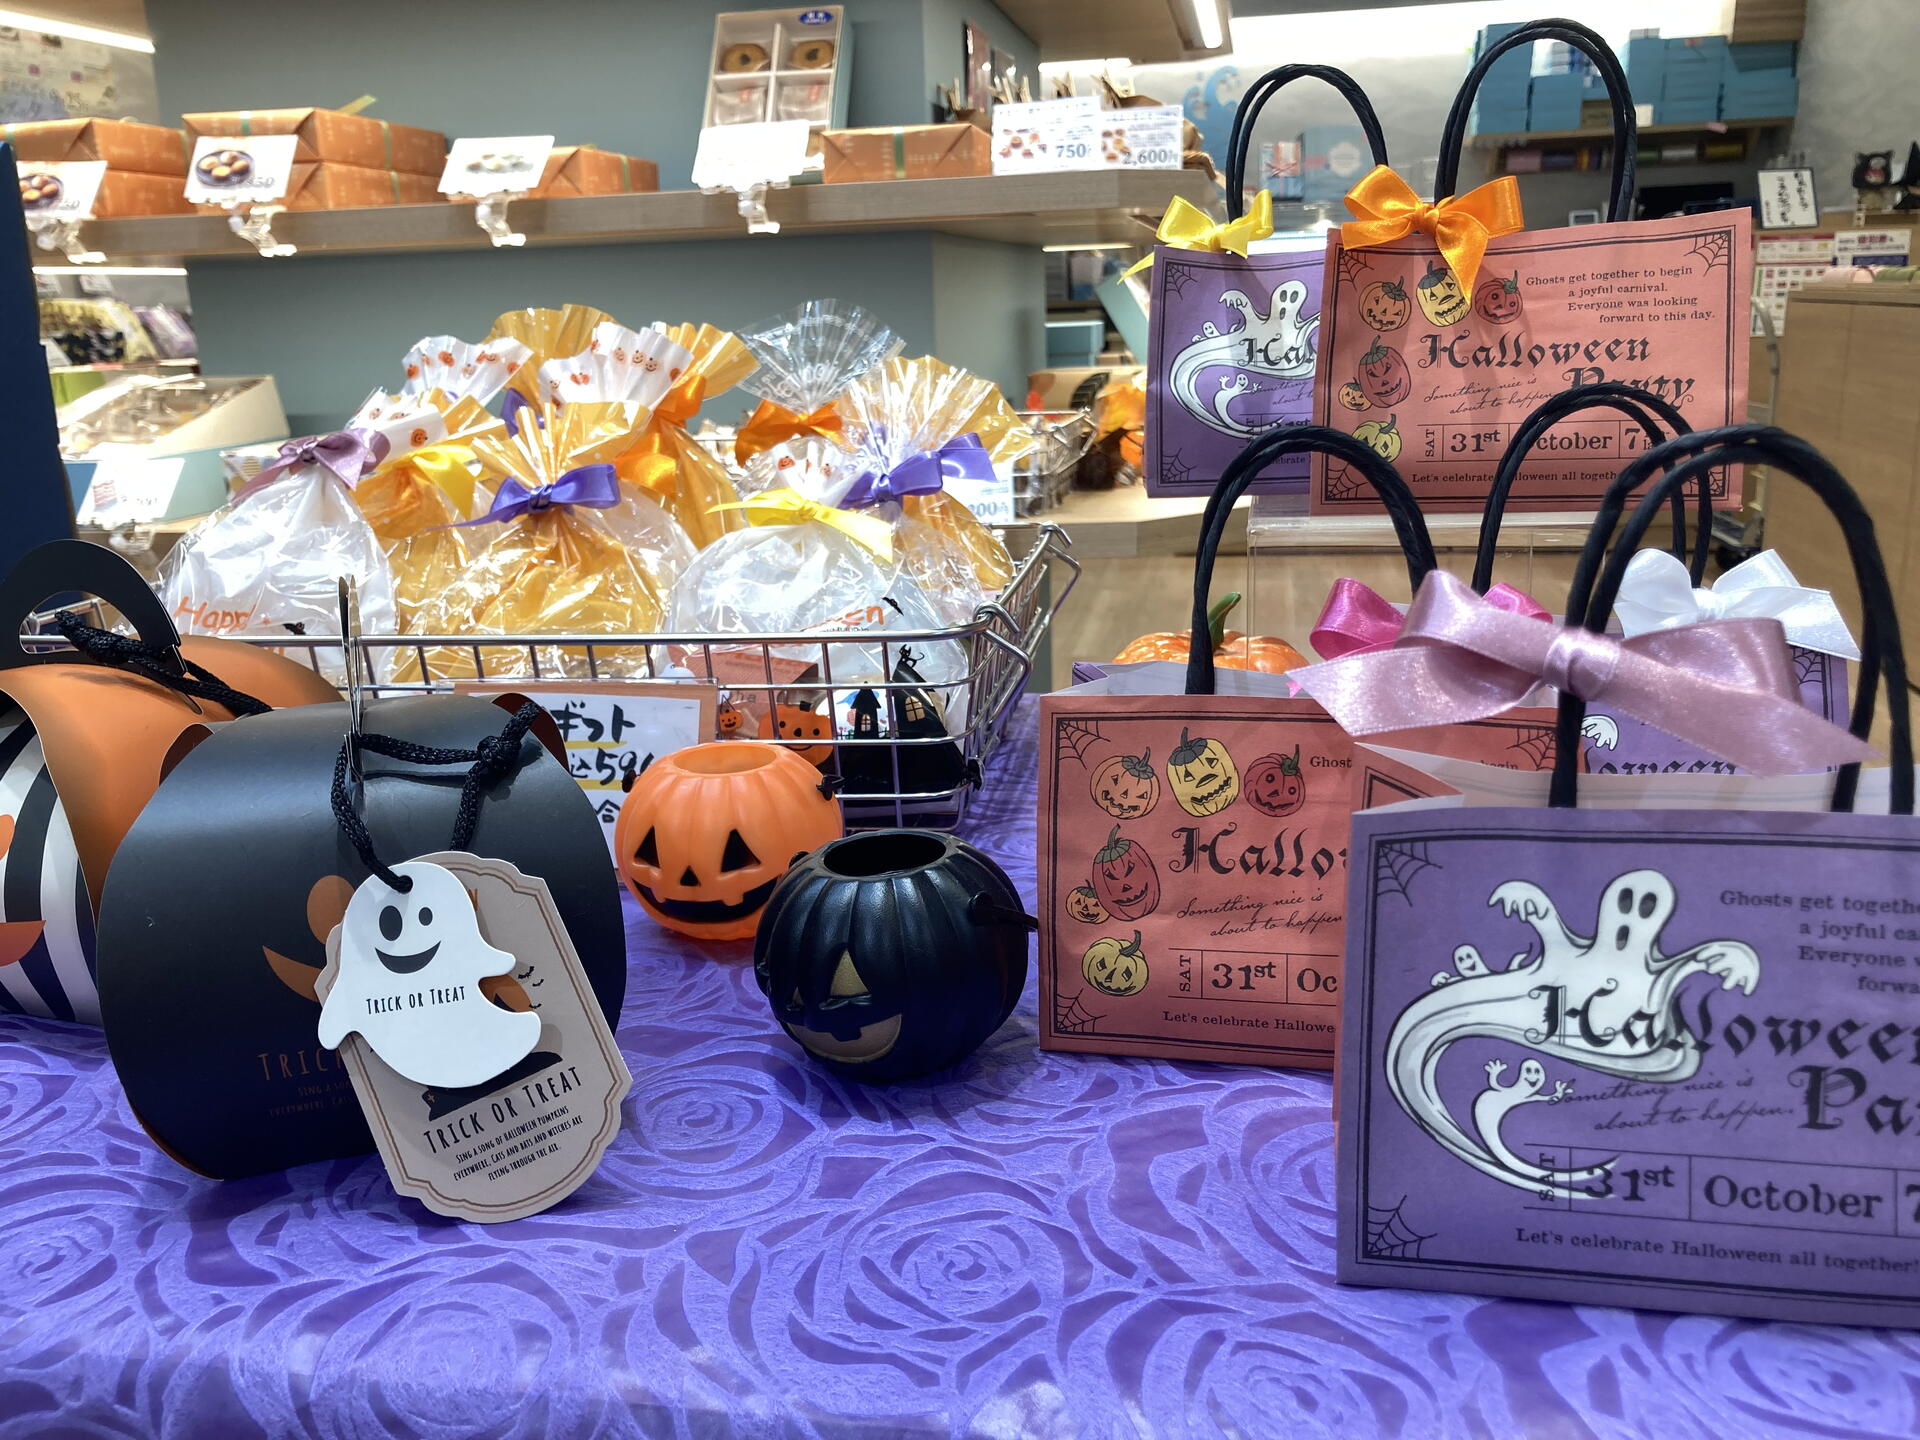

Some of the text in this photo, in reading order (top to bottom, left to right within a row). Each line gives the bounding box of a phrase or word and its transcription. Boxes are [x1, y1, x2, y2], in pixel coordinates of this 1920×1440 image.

[1526, 266, 1693, 286] Ghosts get together to begin
[1579, 285, 1613, 298] joyful
[1617, 283, 1667, 294] carnival.
[1568, 302, 1623, 312] Everyone
[1653, 296, 1698, 307] looking
[1600, 310, 1715, 323] forward to this day.
[1417, 329, 1652, 369] Halloween
[1424, 373, 1537, 403] Something nice is
[1449, 401, 1488, 415] about
[1491, 398, 1509, 407] to
[1426, 429, 1435, 457] SAT
[1451, 430, 1502, 453] 31st
[1536, 432, 1613, 451] ctober
[1625, 428, 1640, 450] 7
[1412, 473, 1440, 483] Let's
[1442, 471, 1494, 482] celebrate
[1562, 470, 1577, 481] all
[1310, 756, 1352, 769] Ghost
[1177, 887, 1323, 921] Something nice is
[1720, 889, 1792, 907] Ghosts
[1799, 896, 1834, 912] get
[1210, 920, 1255, 937] about
[1261, 916, 1282, 931] to
[1799, 922, 1811, 934] a
[1819, 921, 1886, 941] joyful
[1798, 945, 1906, 968] Everyone
[1179, 955, 1338, 993] SAT 31st Oc
[1162, 1010, 1198, 1024] Let's
[1202, 1014, 1269, 1029] celebrate
[1548, 1072, 1754, 1106] Something nice is
[1788, 1064, 1920, 1137] Pa
[1594, 1107, 1659, 1132] about
[1662, 1105, 1692, 1125] to
[1539, 1153, 1555, 1202] SAT
[1584, 1164, 1675, 1202] 31st
[1704, 1175, 1884, 1219] October
[1516, 1228, 1920, 1275] Let's celebrate Halloween all together!
